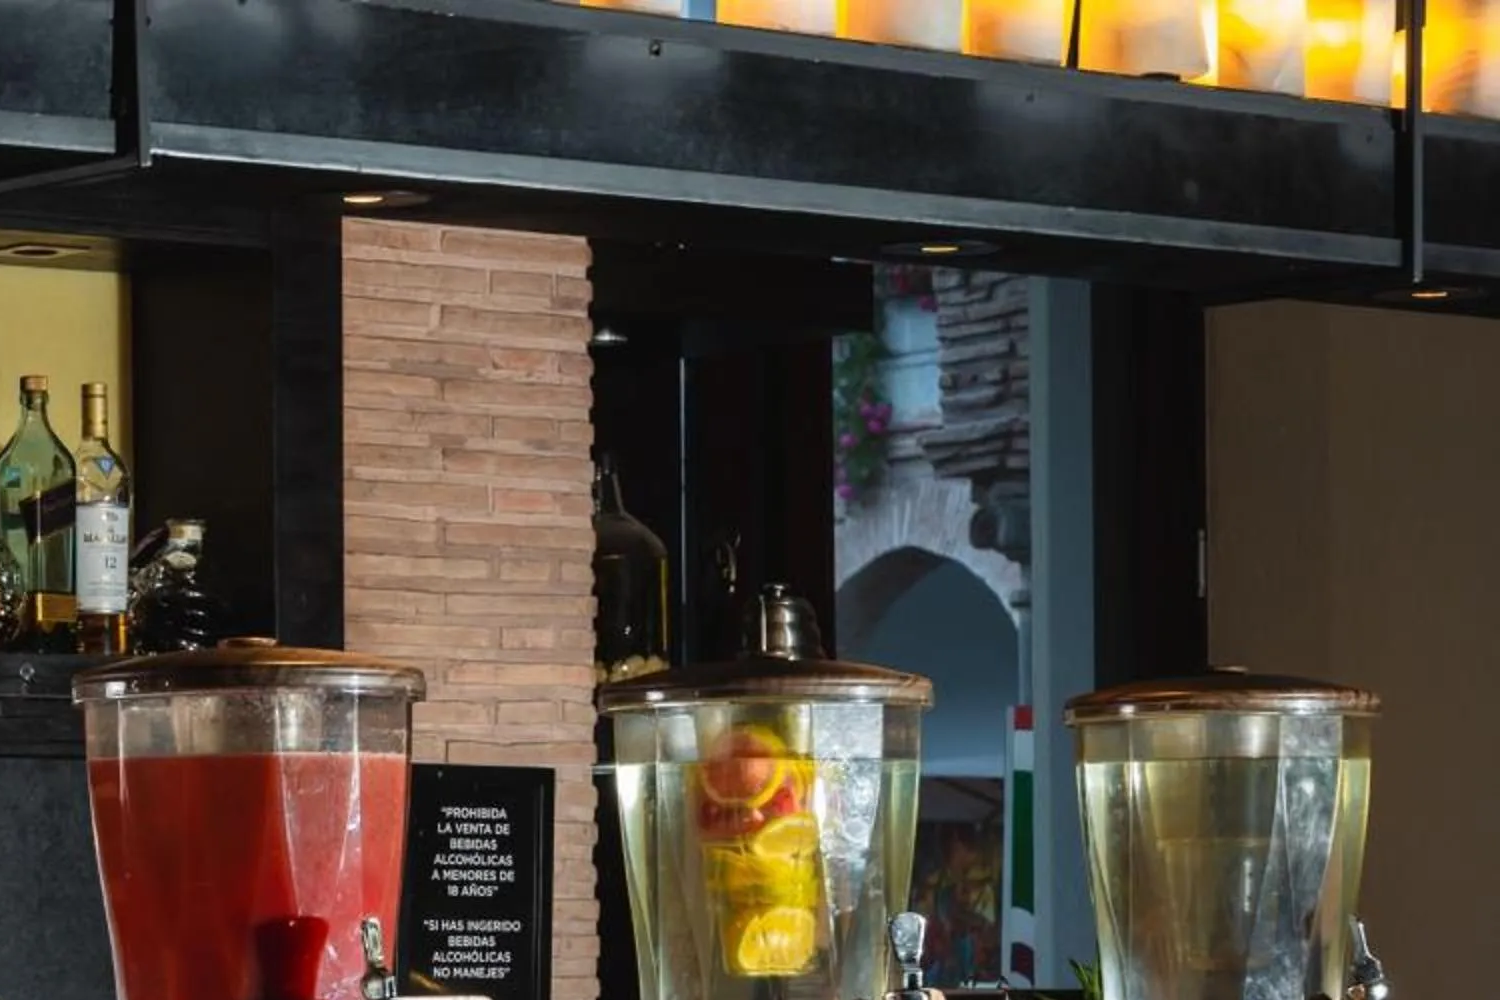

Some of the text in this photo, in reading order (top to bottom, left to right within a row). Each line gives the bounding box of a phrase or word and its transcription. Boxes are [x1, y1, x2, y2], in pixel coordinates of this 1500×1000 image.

[105, 556, 117, 569] 12
[437, 822, 510, 836] LA VENTA DE
[449, 837, 498, 851] BEBIDAS
[433, 852, 513, 867] ALCOHÓLICAS
[431, 869, 515, 882] A MENORES DE
[447, 885, 459, 897] 18
[441, 919, 465, 932] HAS
[466, 920, 521, 932] INGERIDO
[447, 936, 497, 948] BEBIDAS
[432, 949, 511, 963] ALCOHÓLICAS
[433, 966, 451, 979] NO
